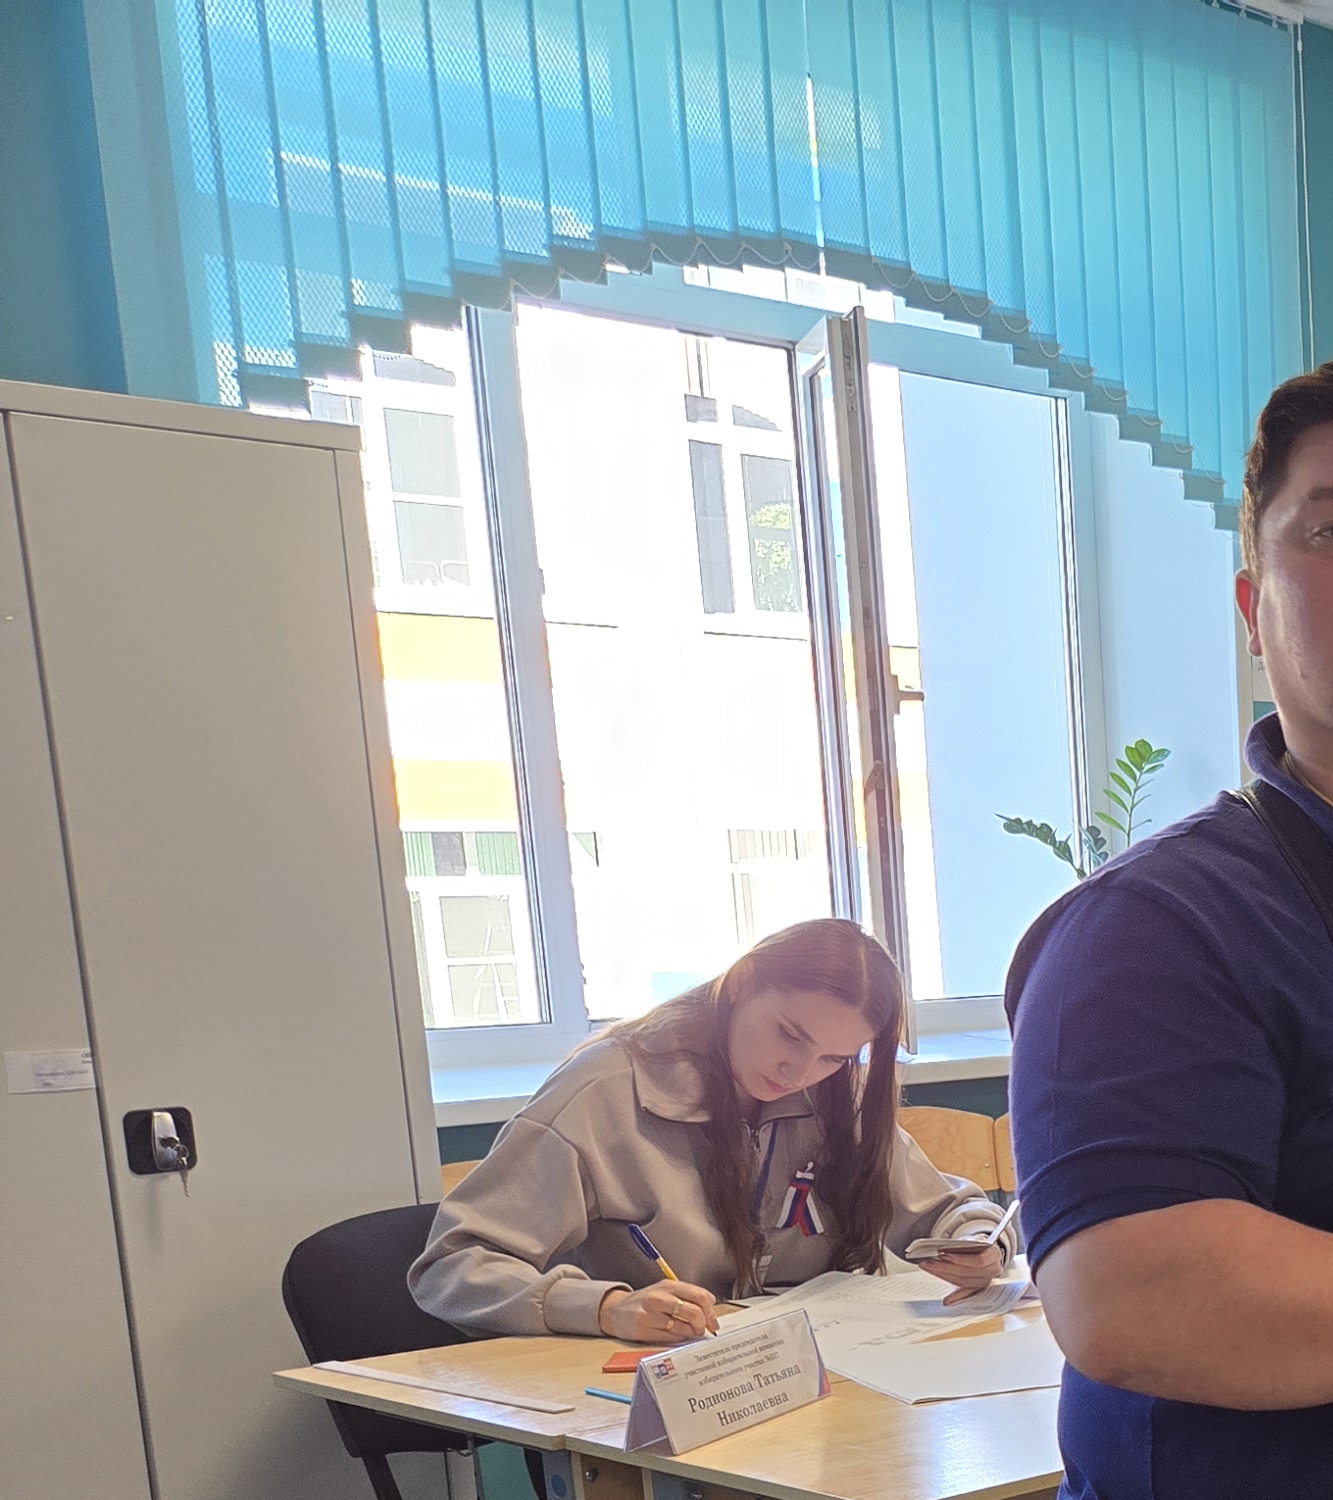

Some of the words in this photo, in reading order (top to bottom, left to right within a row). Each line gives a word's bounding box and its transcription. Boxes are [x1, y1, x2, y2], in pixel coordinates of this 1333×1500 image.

[687, 1378, 754, 1414] Родионова
[754, 1363, 802, 1389] Татьяна
[717, 1392, 789, 1427] Николаевна
